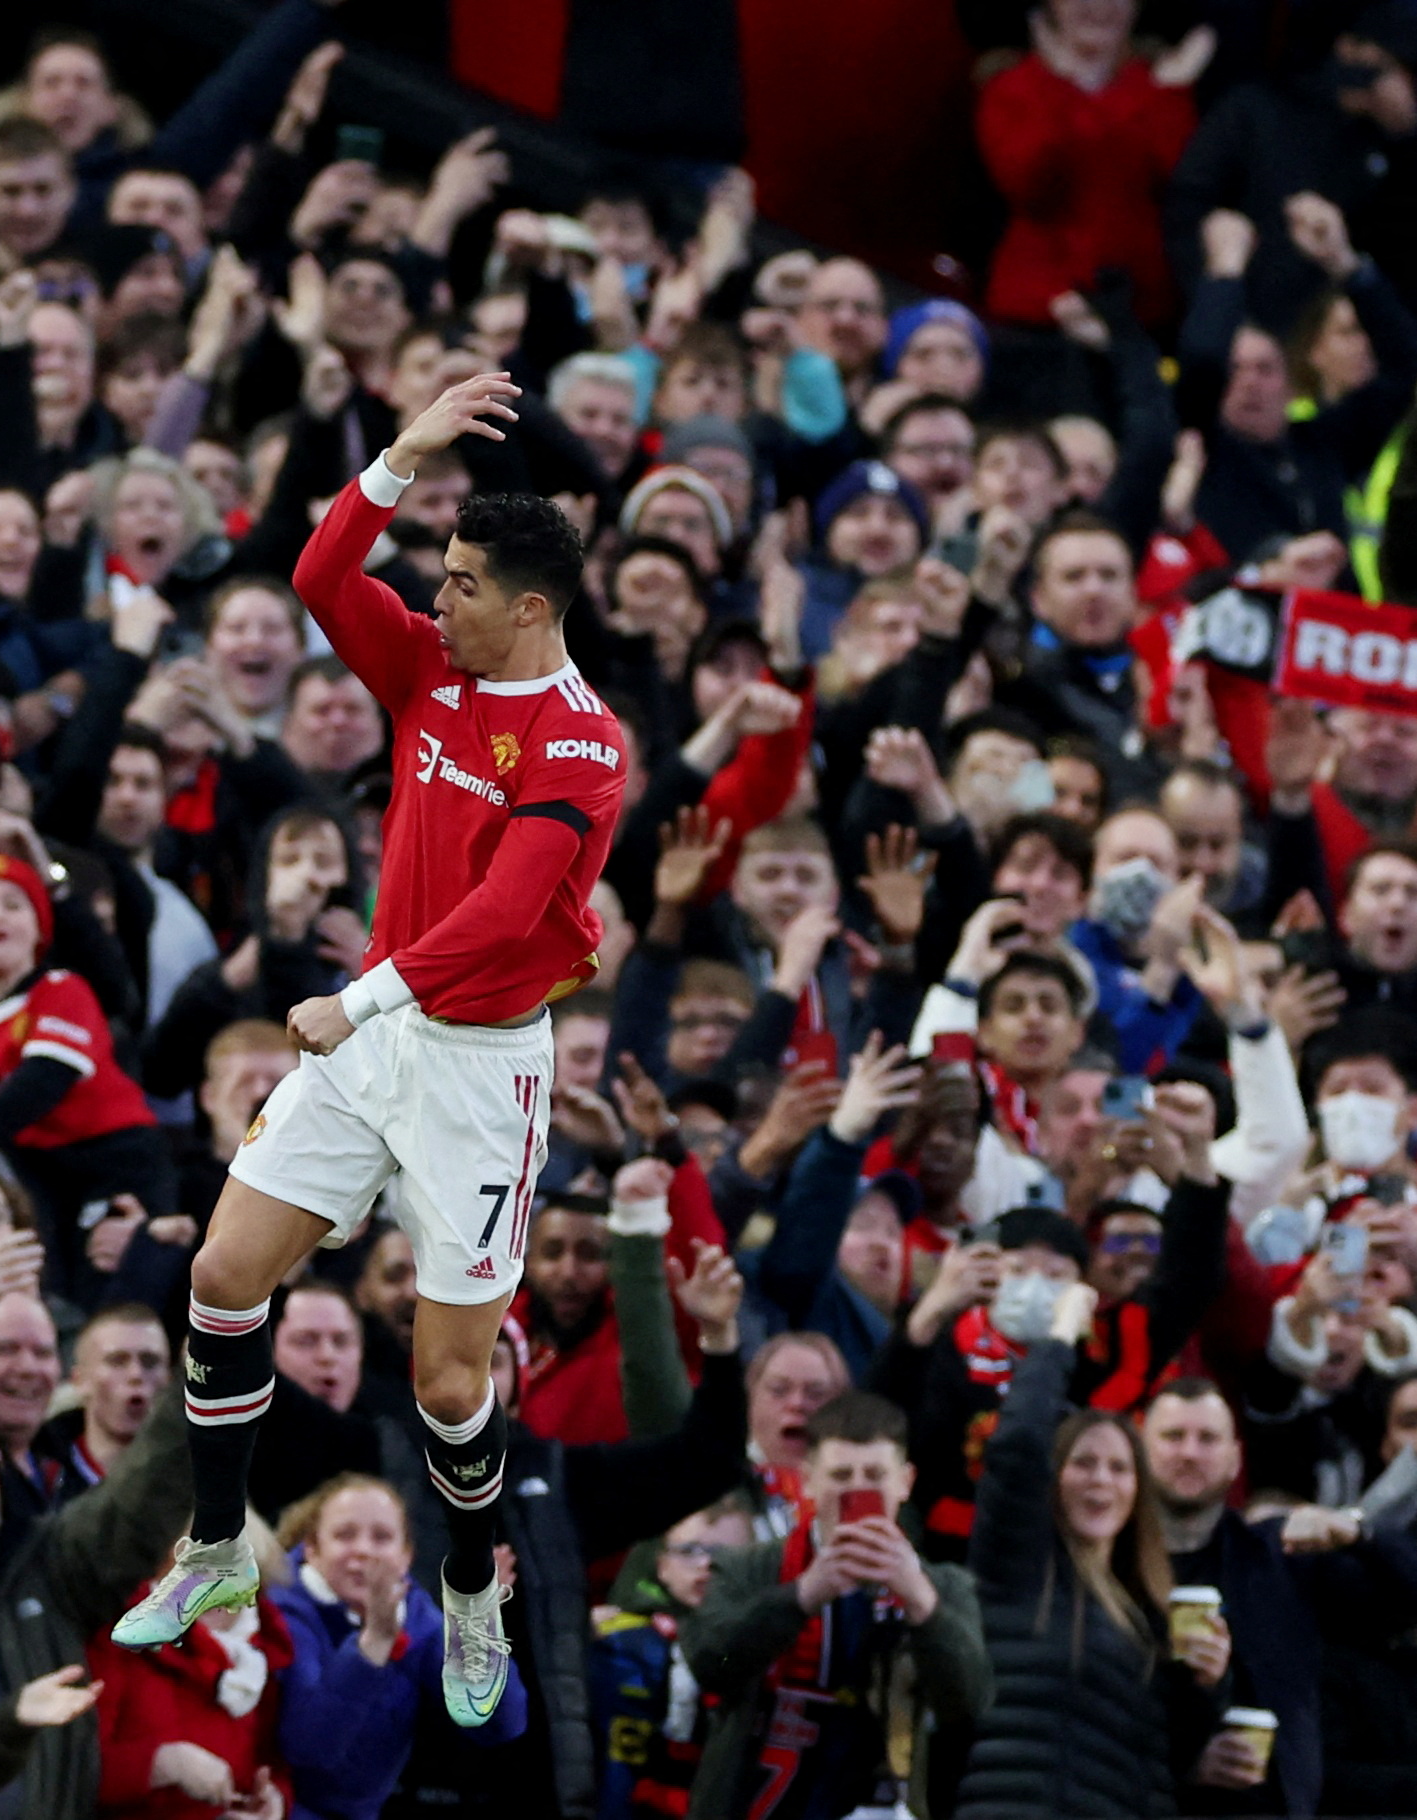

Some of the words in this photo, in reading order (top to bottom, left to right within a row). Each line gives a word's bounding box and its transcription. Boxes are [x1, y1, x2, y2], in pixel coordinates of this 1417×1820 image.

[546, 738, 619, 772] KOHLER
[437, 754, 510, 809] TeamVie
[477, 1184, 511, 1249] 7
[465, 1268, 497, 1280] adidas
